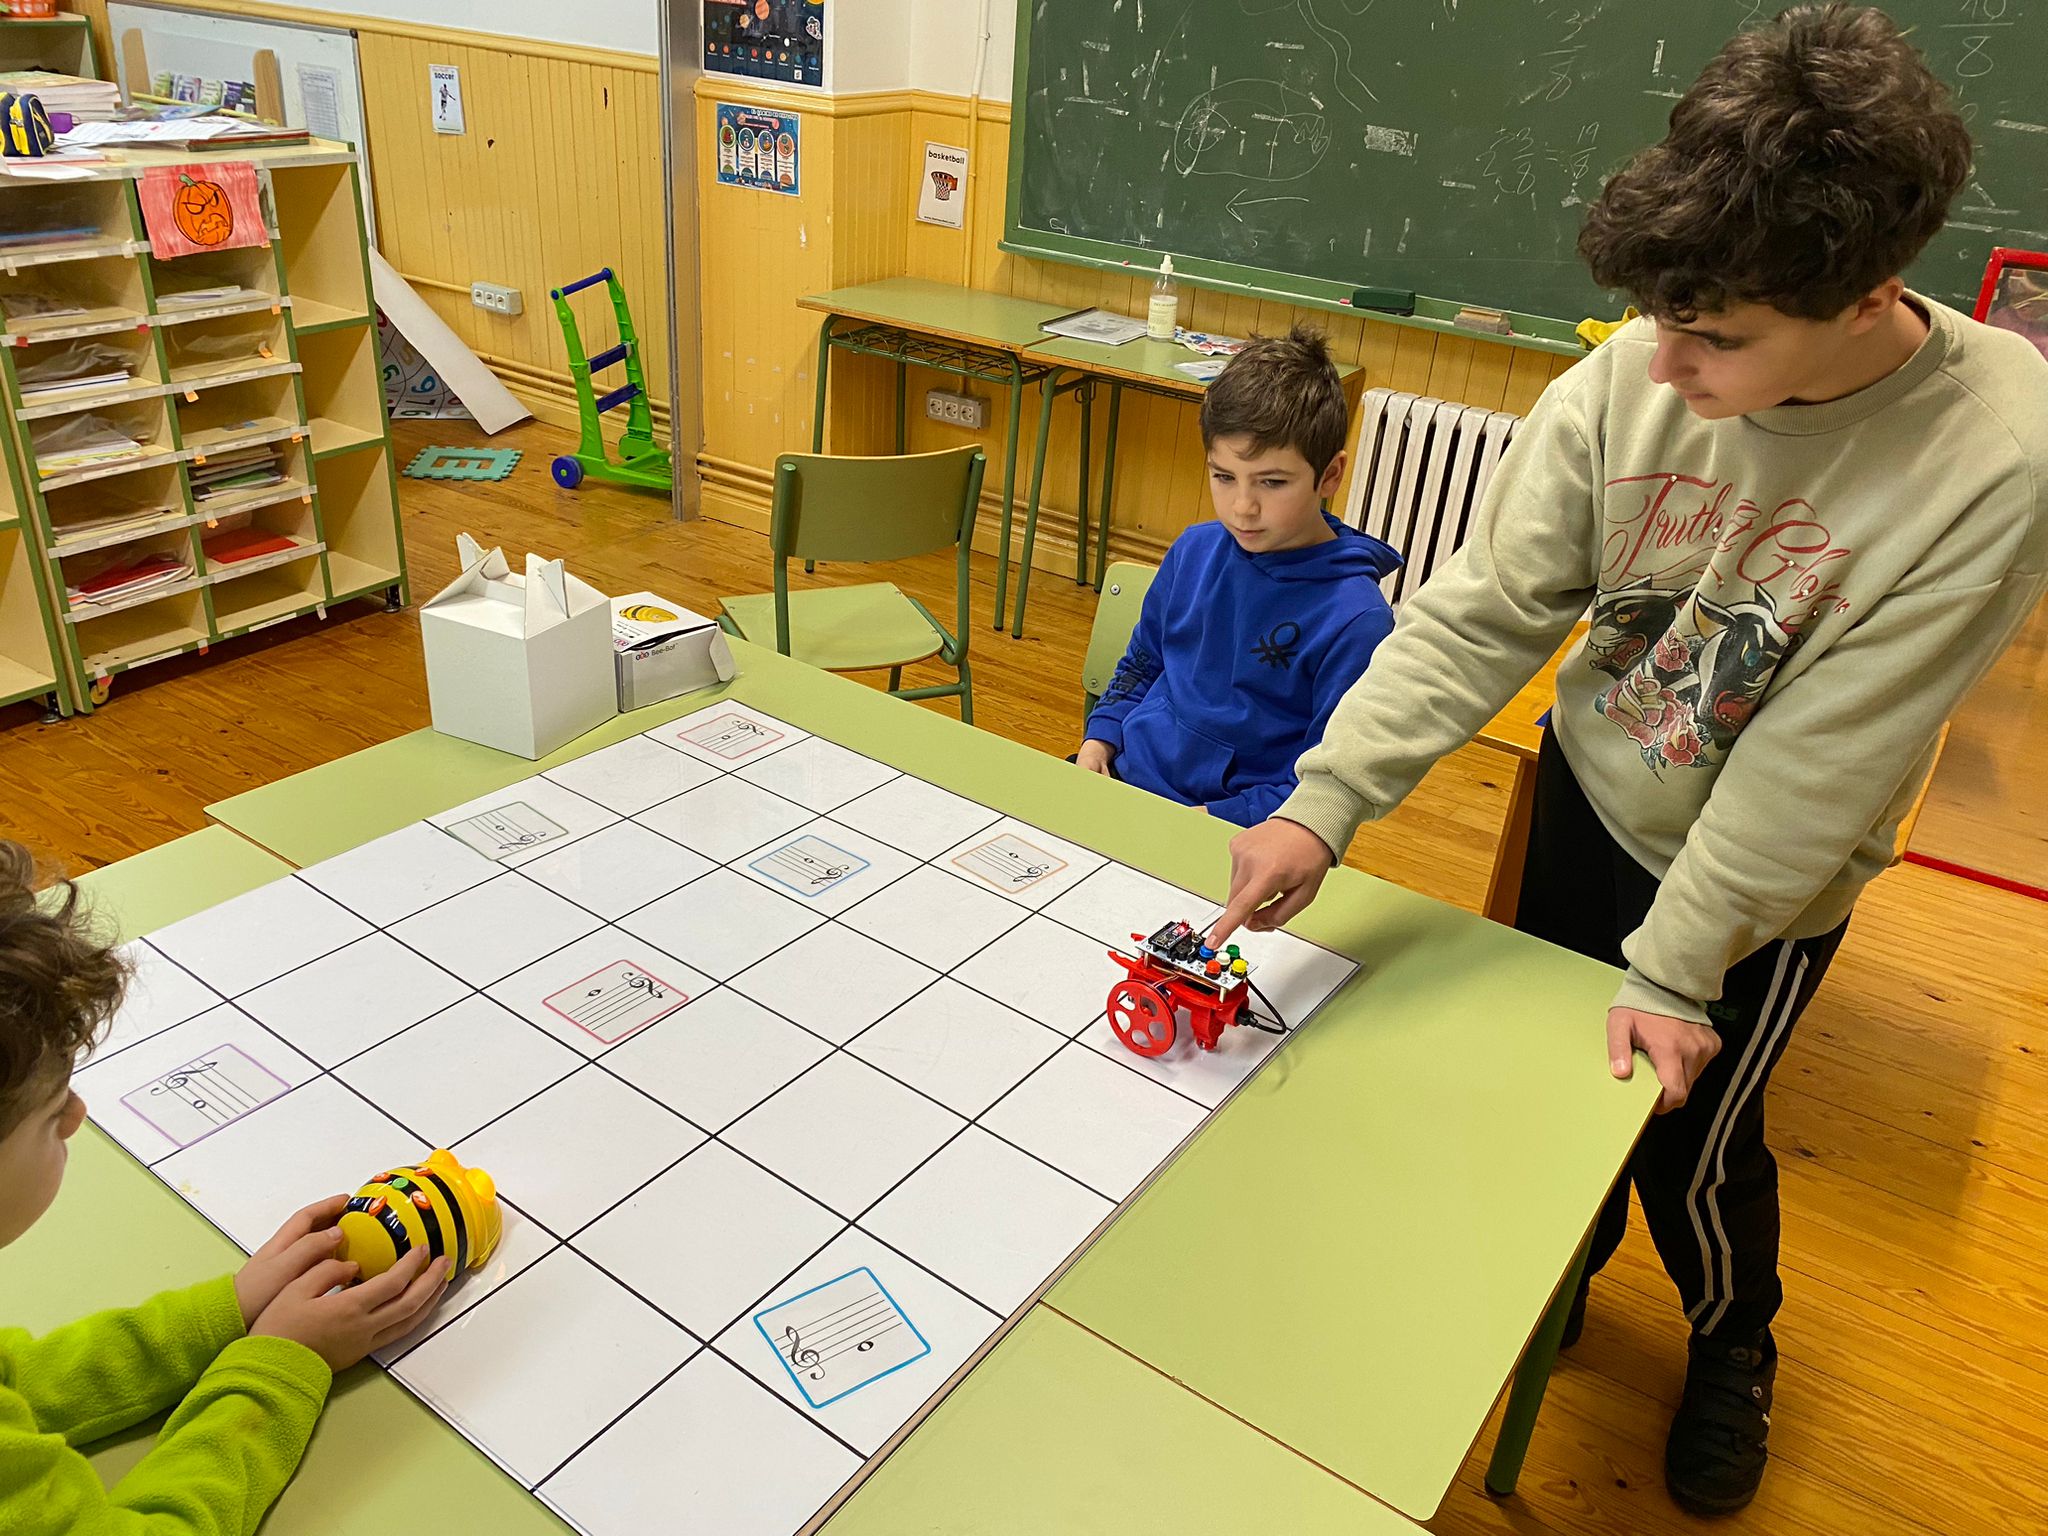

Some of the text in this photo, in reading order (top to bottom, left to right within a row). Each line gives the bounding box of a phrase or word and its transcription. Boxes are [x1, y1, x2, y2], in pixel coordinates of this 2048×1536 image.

[1956, 36, 1994, 77] 8
[928, 150, 965, 165] basketball
[1602, 472, 1734, 586] Truth
